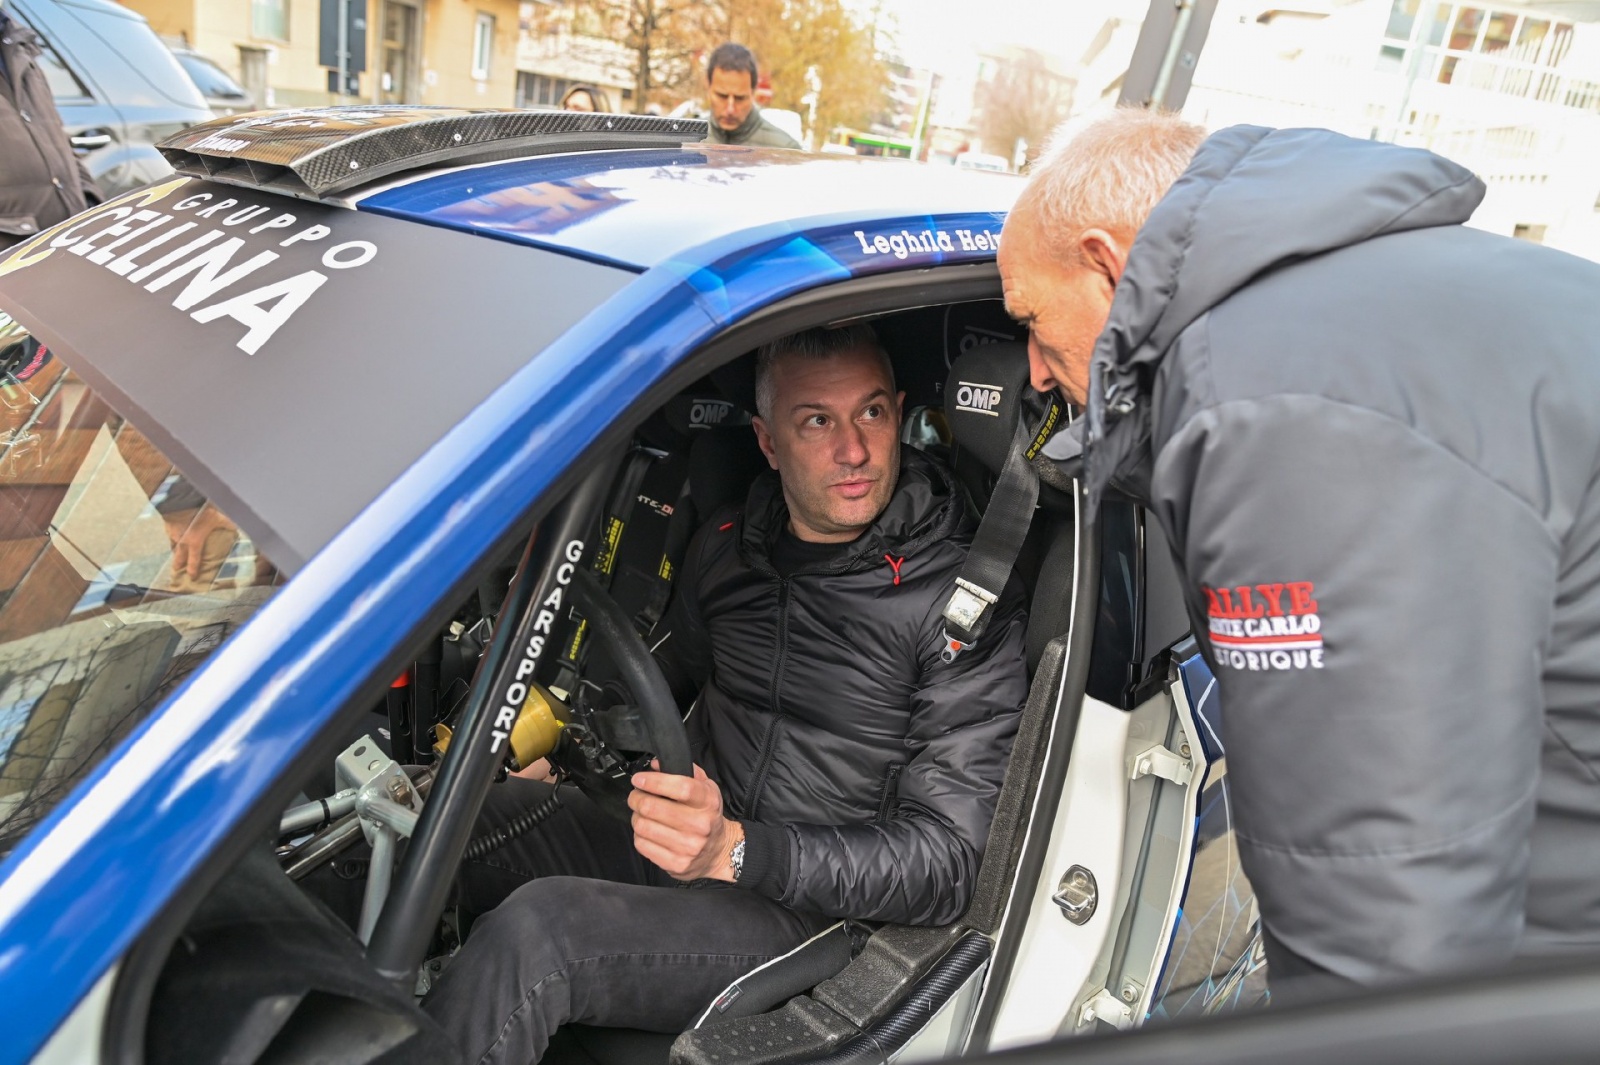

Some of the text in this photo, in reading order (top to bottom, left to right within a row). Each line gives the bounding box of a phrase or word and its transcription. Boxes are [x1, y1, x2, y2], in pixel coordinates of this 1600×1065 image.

[172, 193, 378, 269] GRUPPO
[854, 230, 954, 260] Leghild
[49, 206, 328, 356] CELLINA
[690, 403, 728, 423] OMP
[957, 386, 1001, 410] OMP
[1203, 581, 1318, 619] ALLYE
[1245, 613, 1321, 638] CARLO
[490, 540, 585, 753] GCARSPORT
[1214, 648, 1325, 671] STORIQUE
